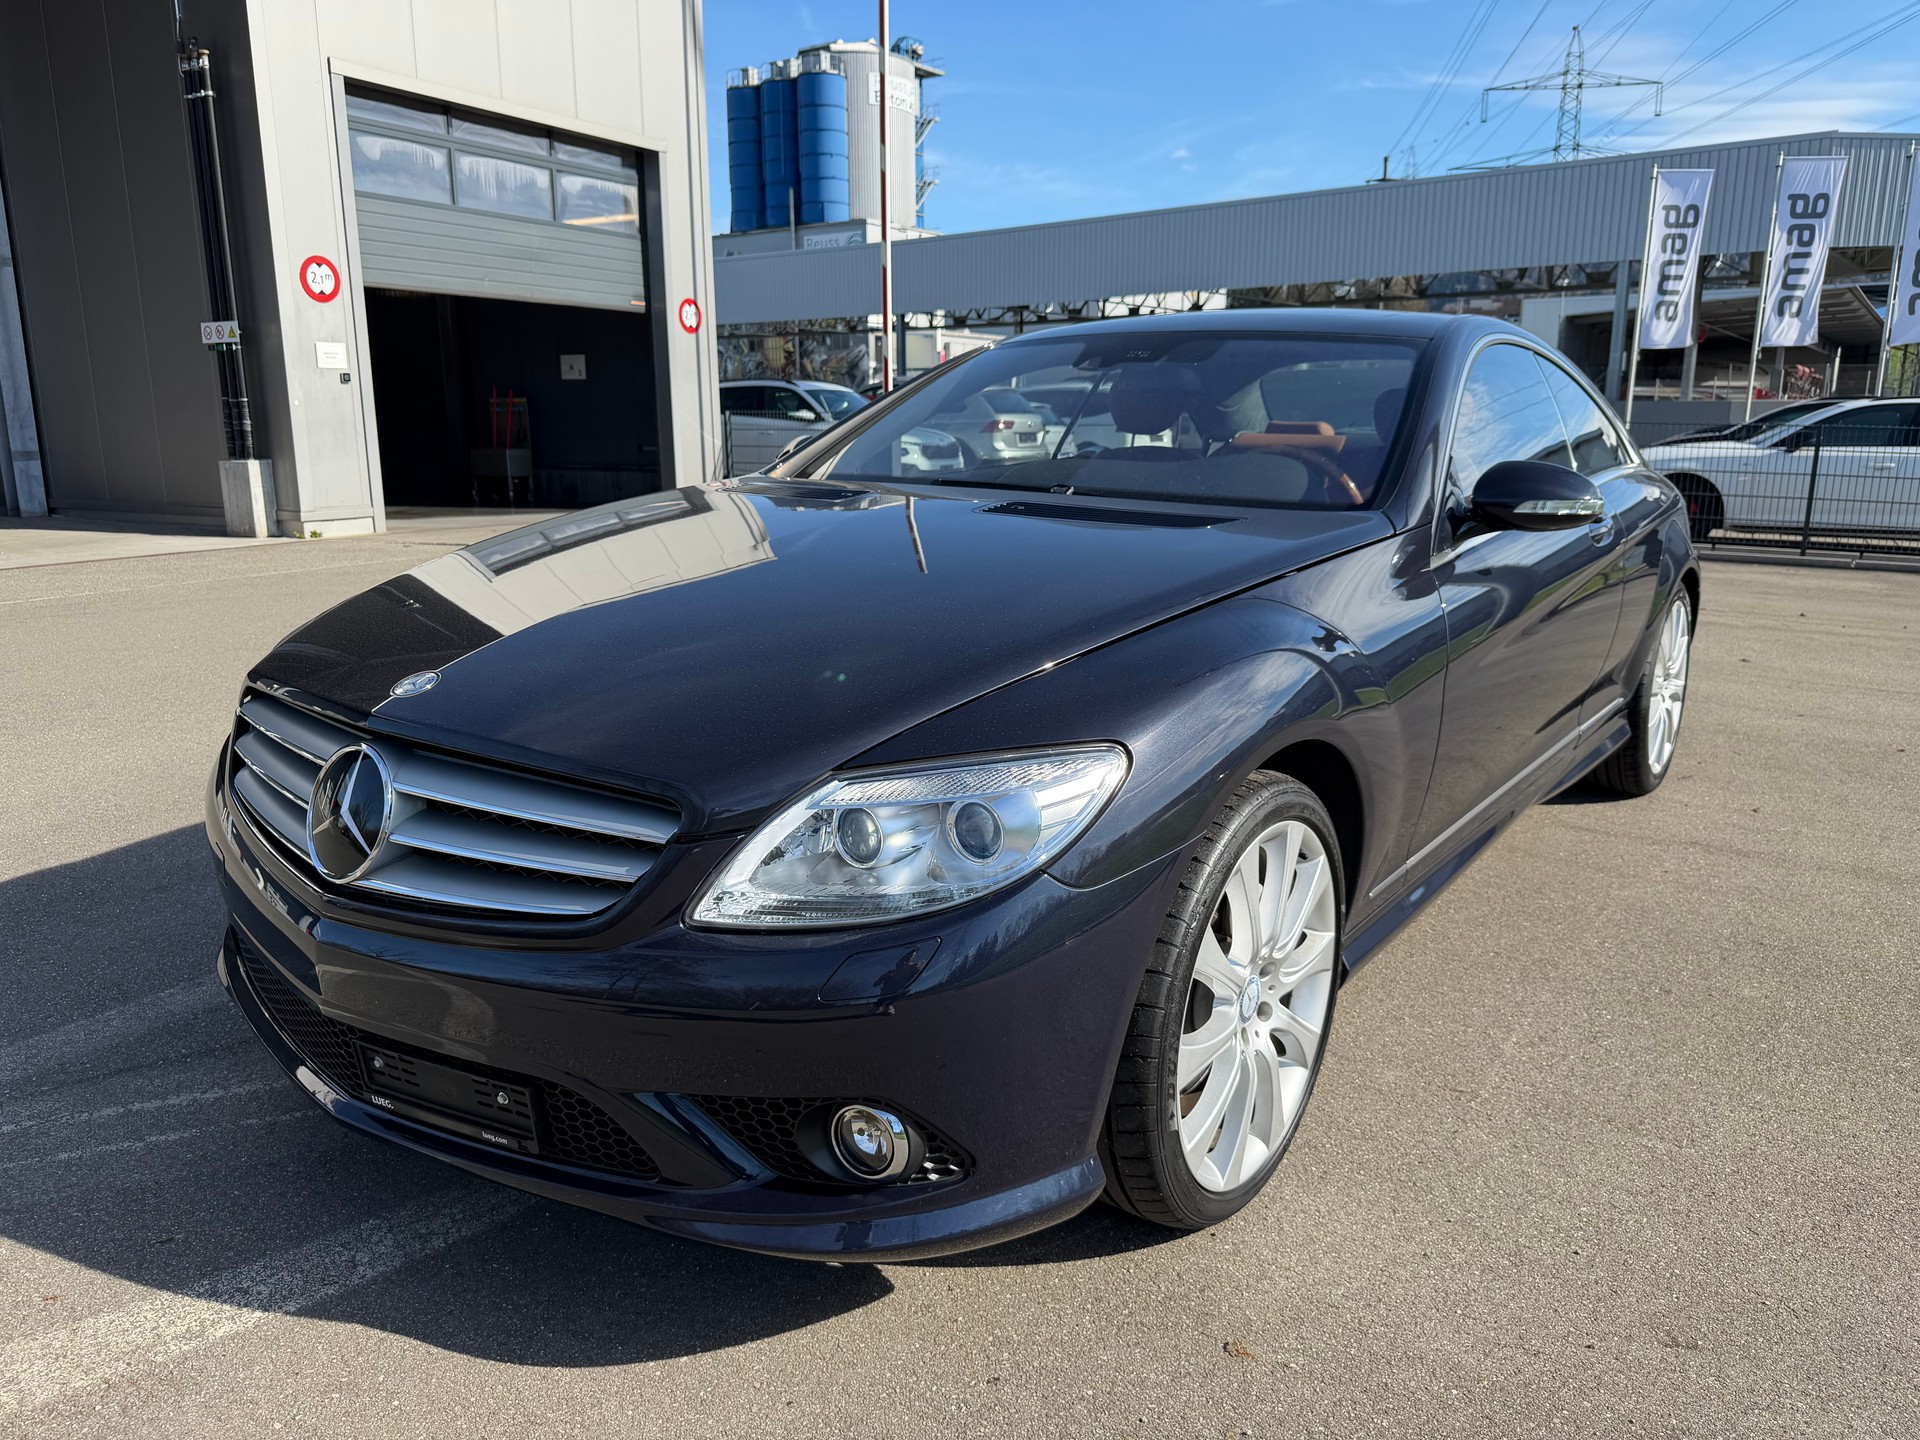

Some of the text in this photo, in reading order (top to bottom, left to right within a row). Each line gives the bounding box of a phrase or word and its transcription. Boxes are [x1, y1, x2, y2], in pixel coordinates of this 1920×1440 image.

[1654, 203, 1700, 322] amag
[1777, 192, 1830, 318] amag
[371, 1094, 394, 1109] LUEG.
